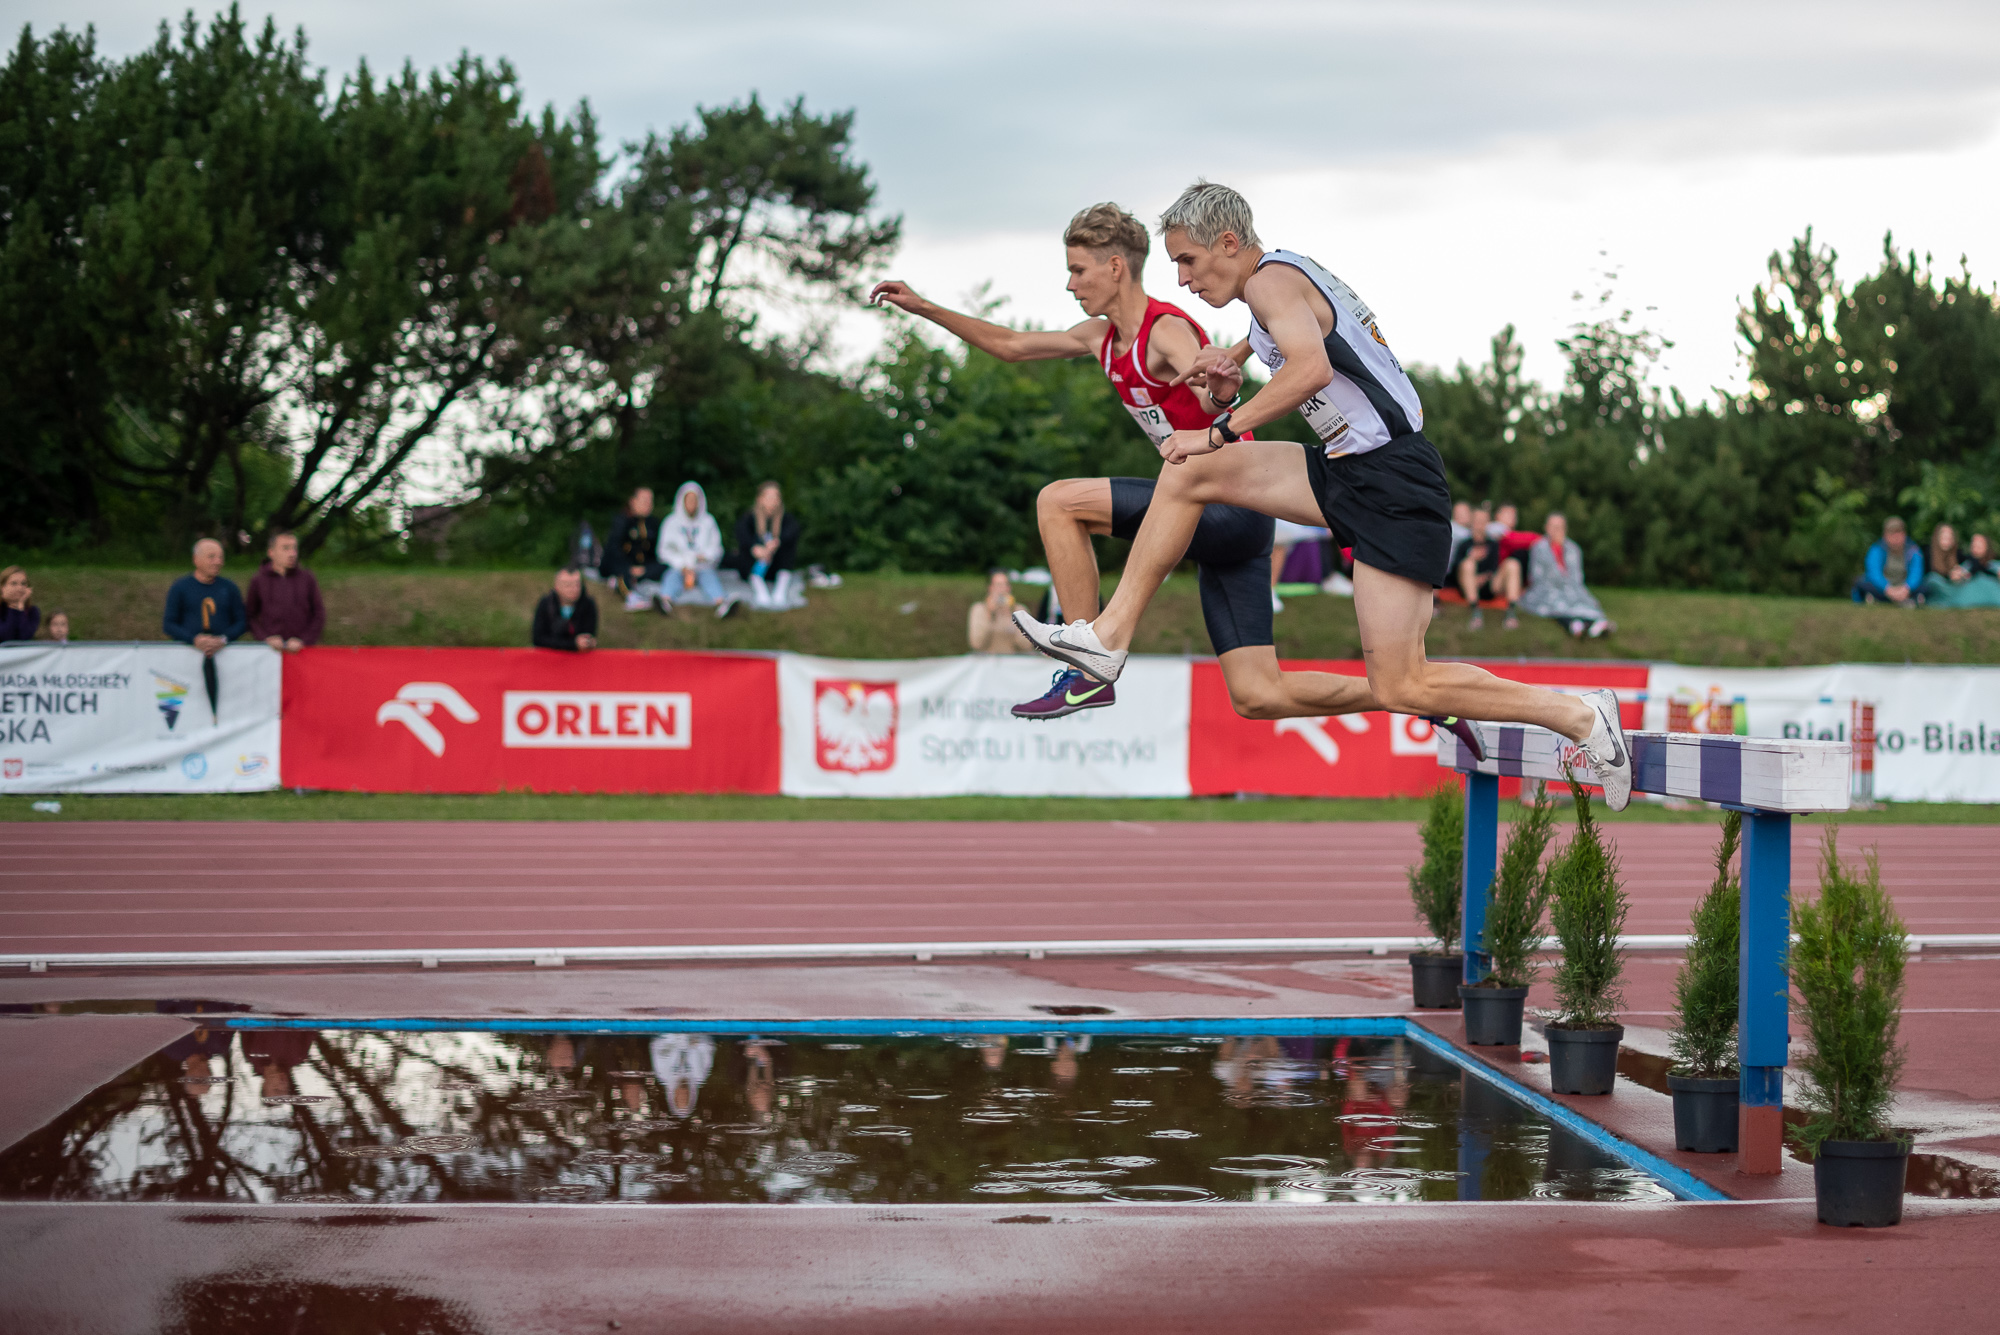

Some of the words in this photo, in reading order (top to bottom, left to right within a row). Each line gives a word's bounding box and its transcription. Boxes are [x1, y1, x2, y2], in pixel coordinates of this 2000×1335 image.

[0, 673, 38, 688] IADA
[0, 691, 98, 714] ETNICH
[516, 703, 675, 736] ORLEN
[1018, 735, 1026, 760] i
[1033, 736, 1157, 767] Turystyki
